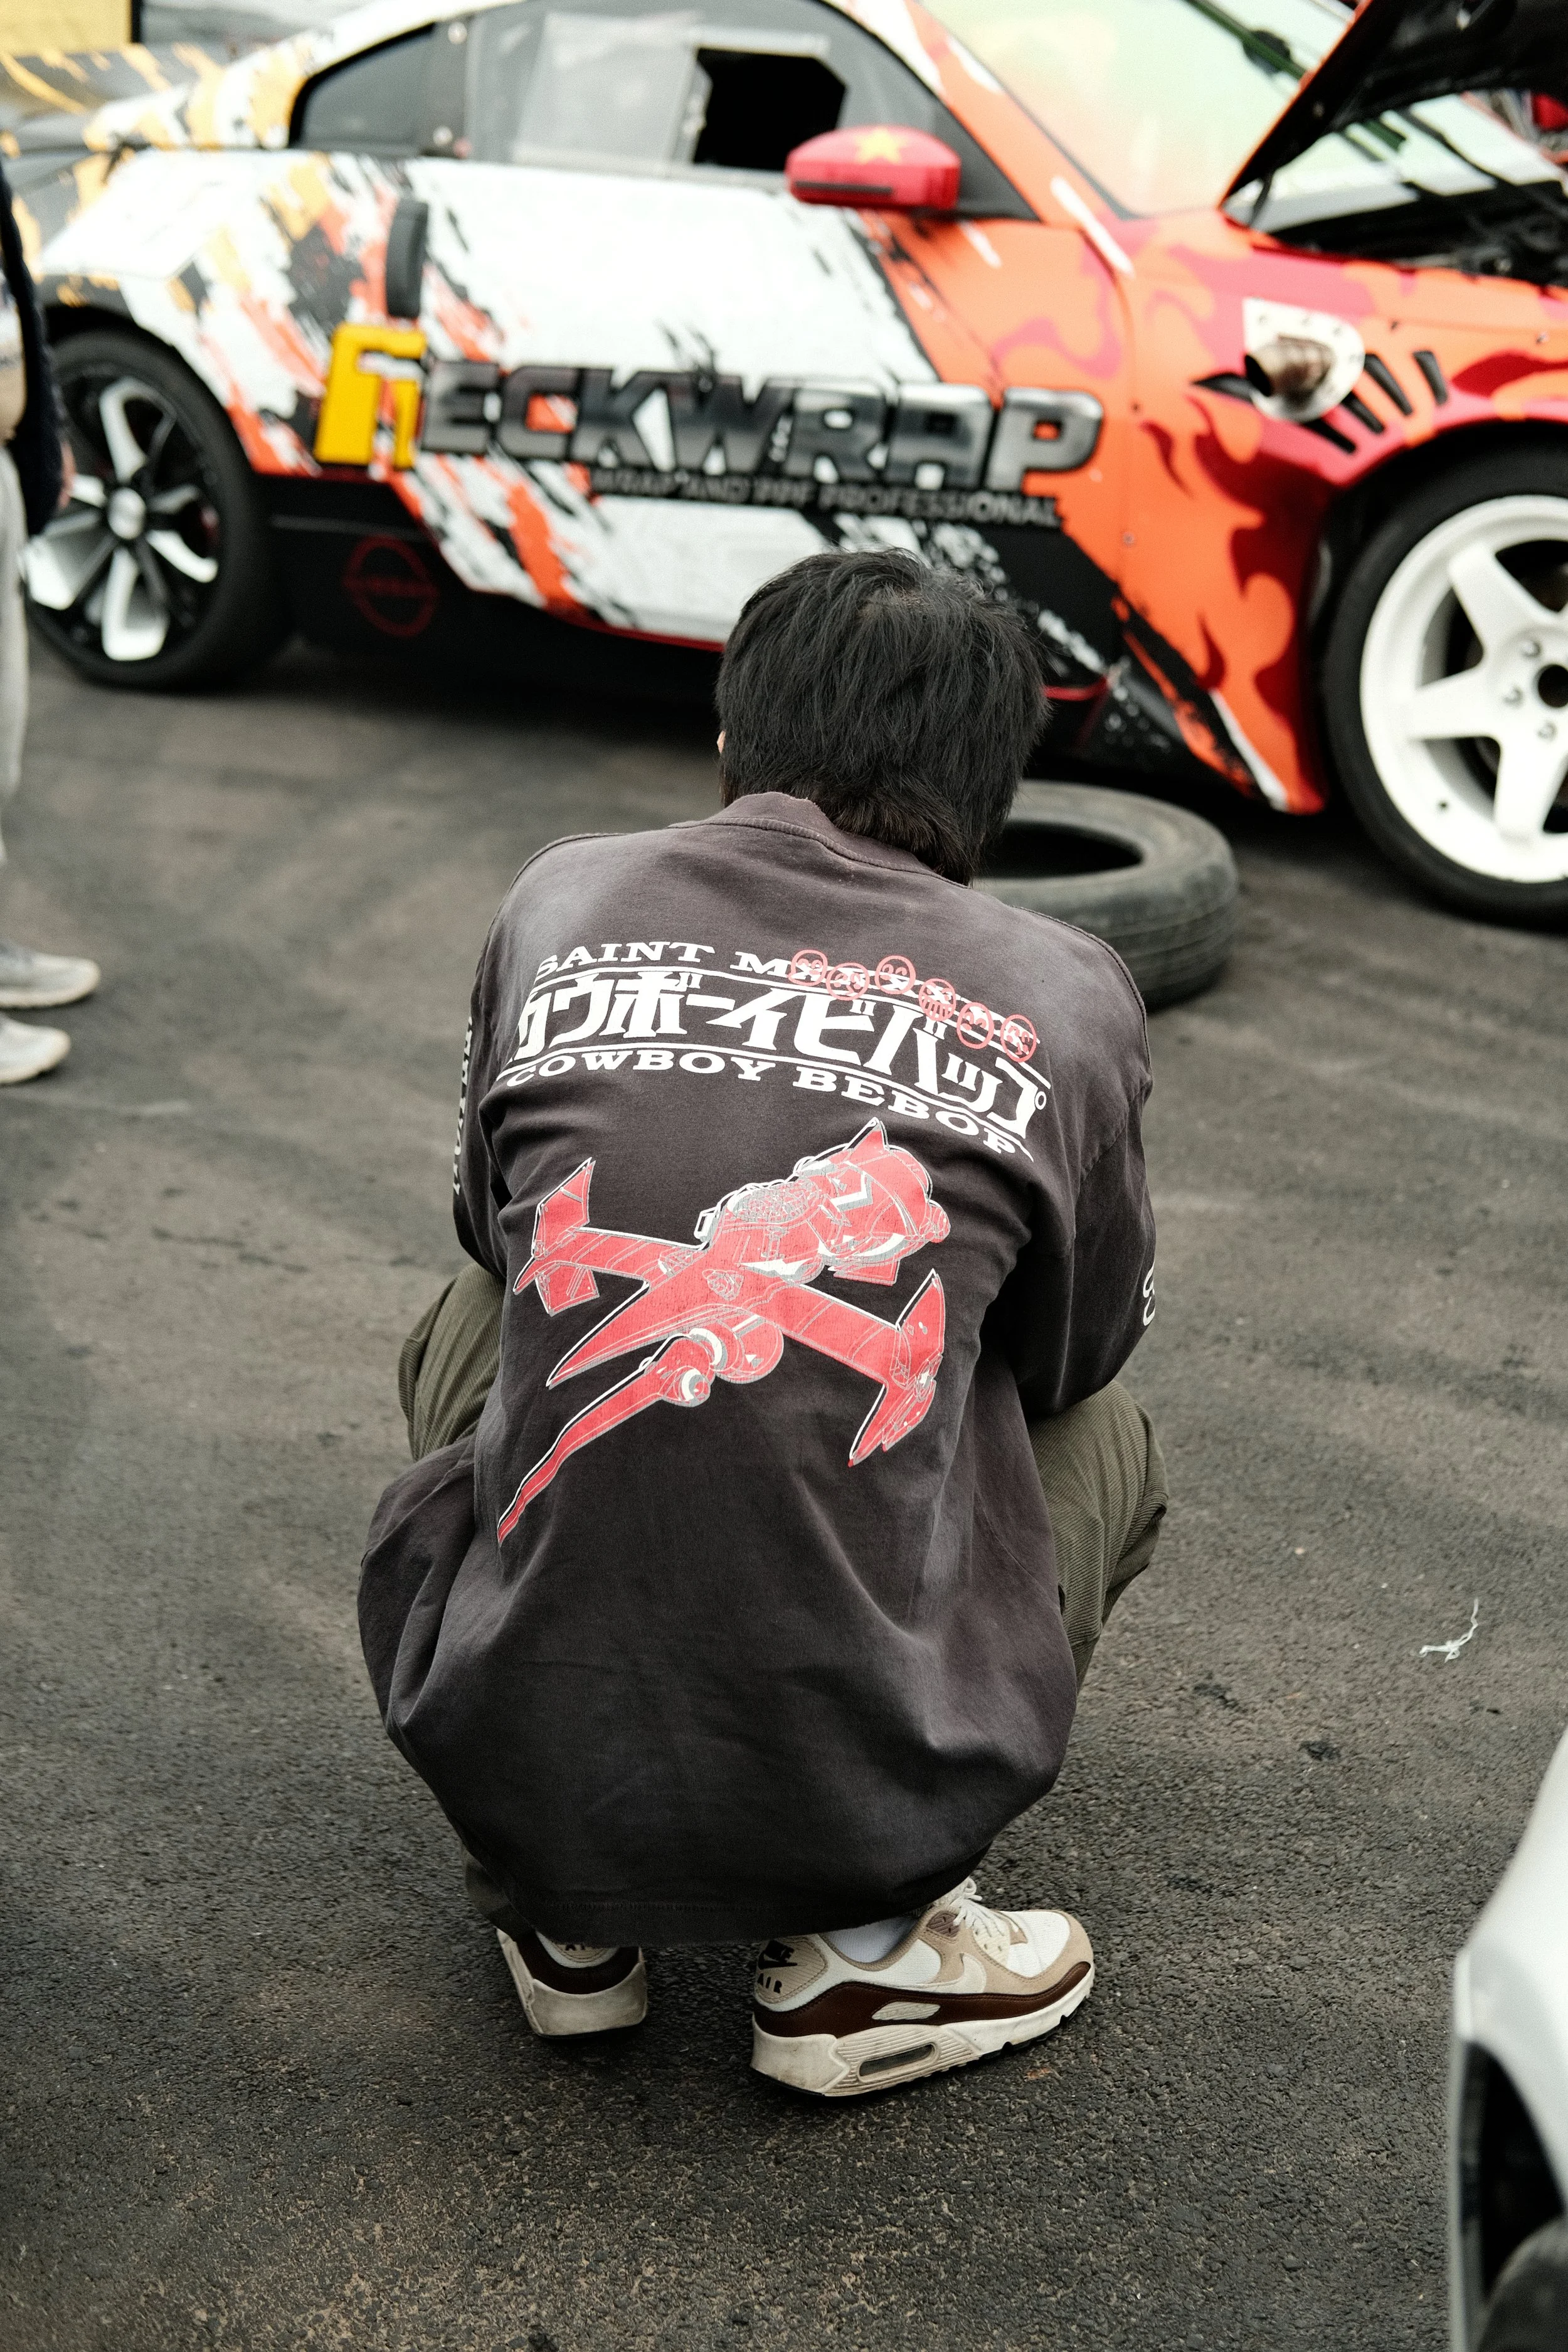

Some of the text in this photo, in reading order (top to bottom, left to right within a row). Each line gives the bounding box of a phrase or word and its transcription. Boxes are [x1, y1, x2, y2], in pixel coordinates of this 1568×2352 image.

[534, 941, 715, 985] SAINT
[507, 1049, 1016, 1154] COWBOY BEBOP
